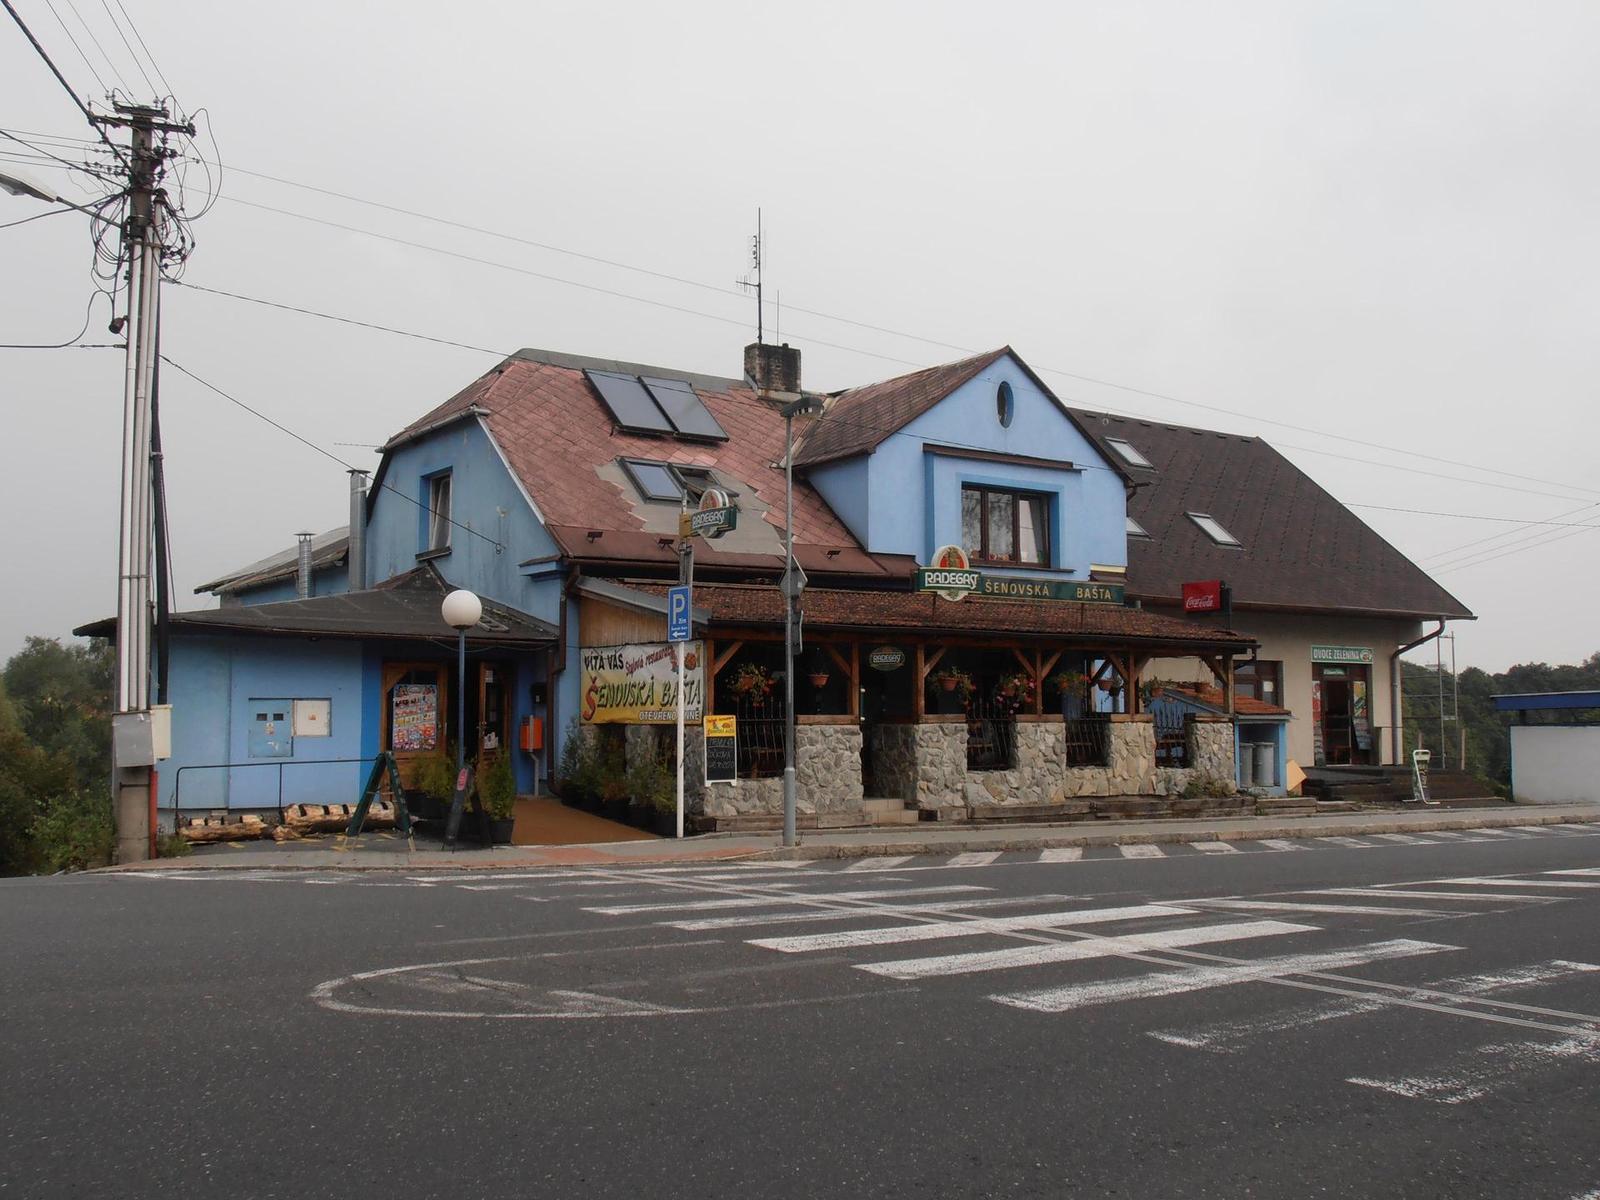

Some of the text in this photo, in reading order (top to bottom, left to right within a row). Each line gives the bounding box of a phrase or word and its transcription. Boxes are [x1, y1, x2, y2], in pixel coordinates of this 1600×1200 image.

[925, 571, 979, 590] RADEGAST
[985, 579, 1112, 600] ŠENOVSKÁ BAŠTA
[673, 594, 685, 624] P
[584, 650, 624, 671] VÍTÁ VÁS
[1313, 648, 1360, 660] OVOCE ZELENINA
[583, 676, 655, 720] ŠENOVSKÁ
